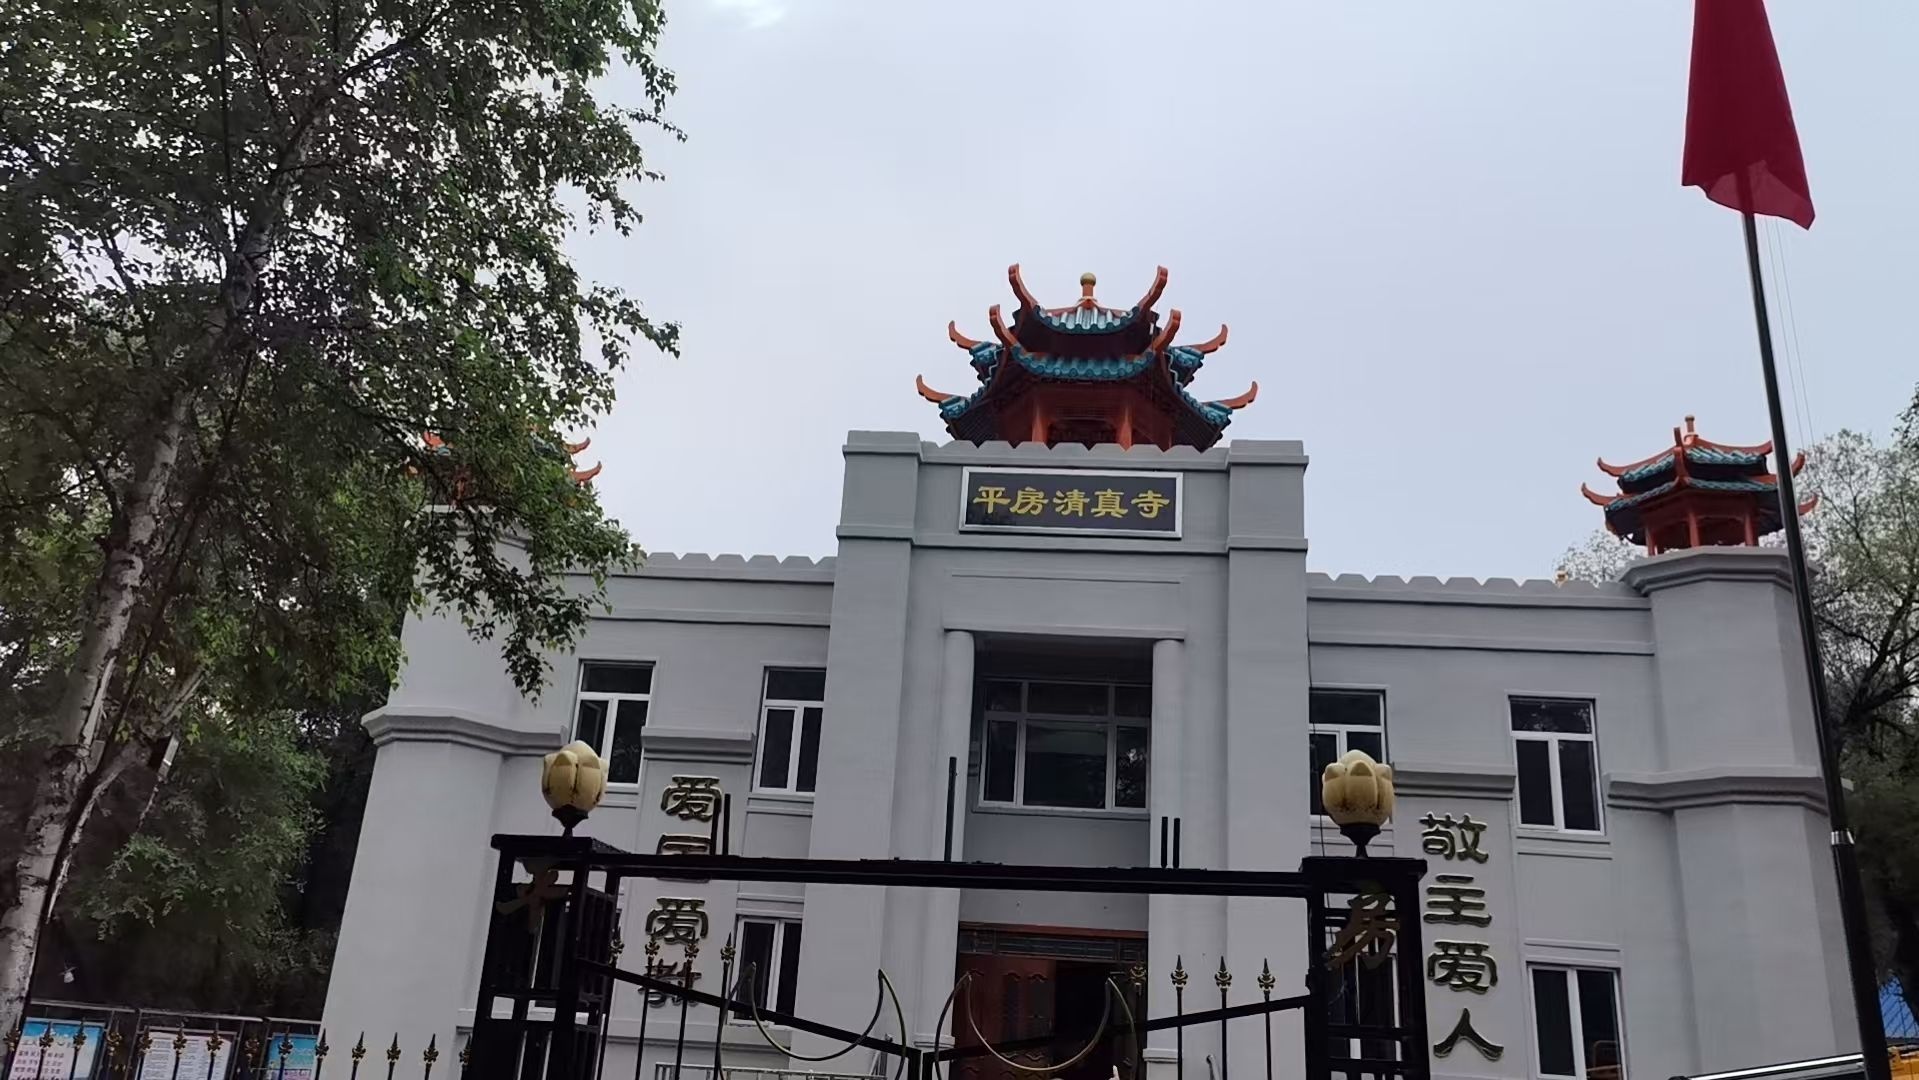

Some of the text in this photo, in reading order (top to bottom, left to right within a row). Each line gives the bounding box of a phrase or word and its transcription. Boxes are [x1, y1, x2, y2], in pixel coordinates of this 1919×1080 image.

[973, 486, 1170, 518] 平房清真寺
[1420, 812, 1504, 1061] 敬主爱人
